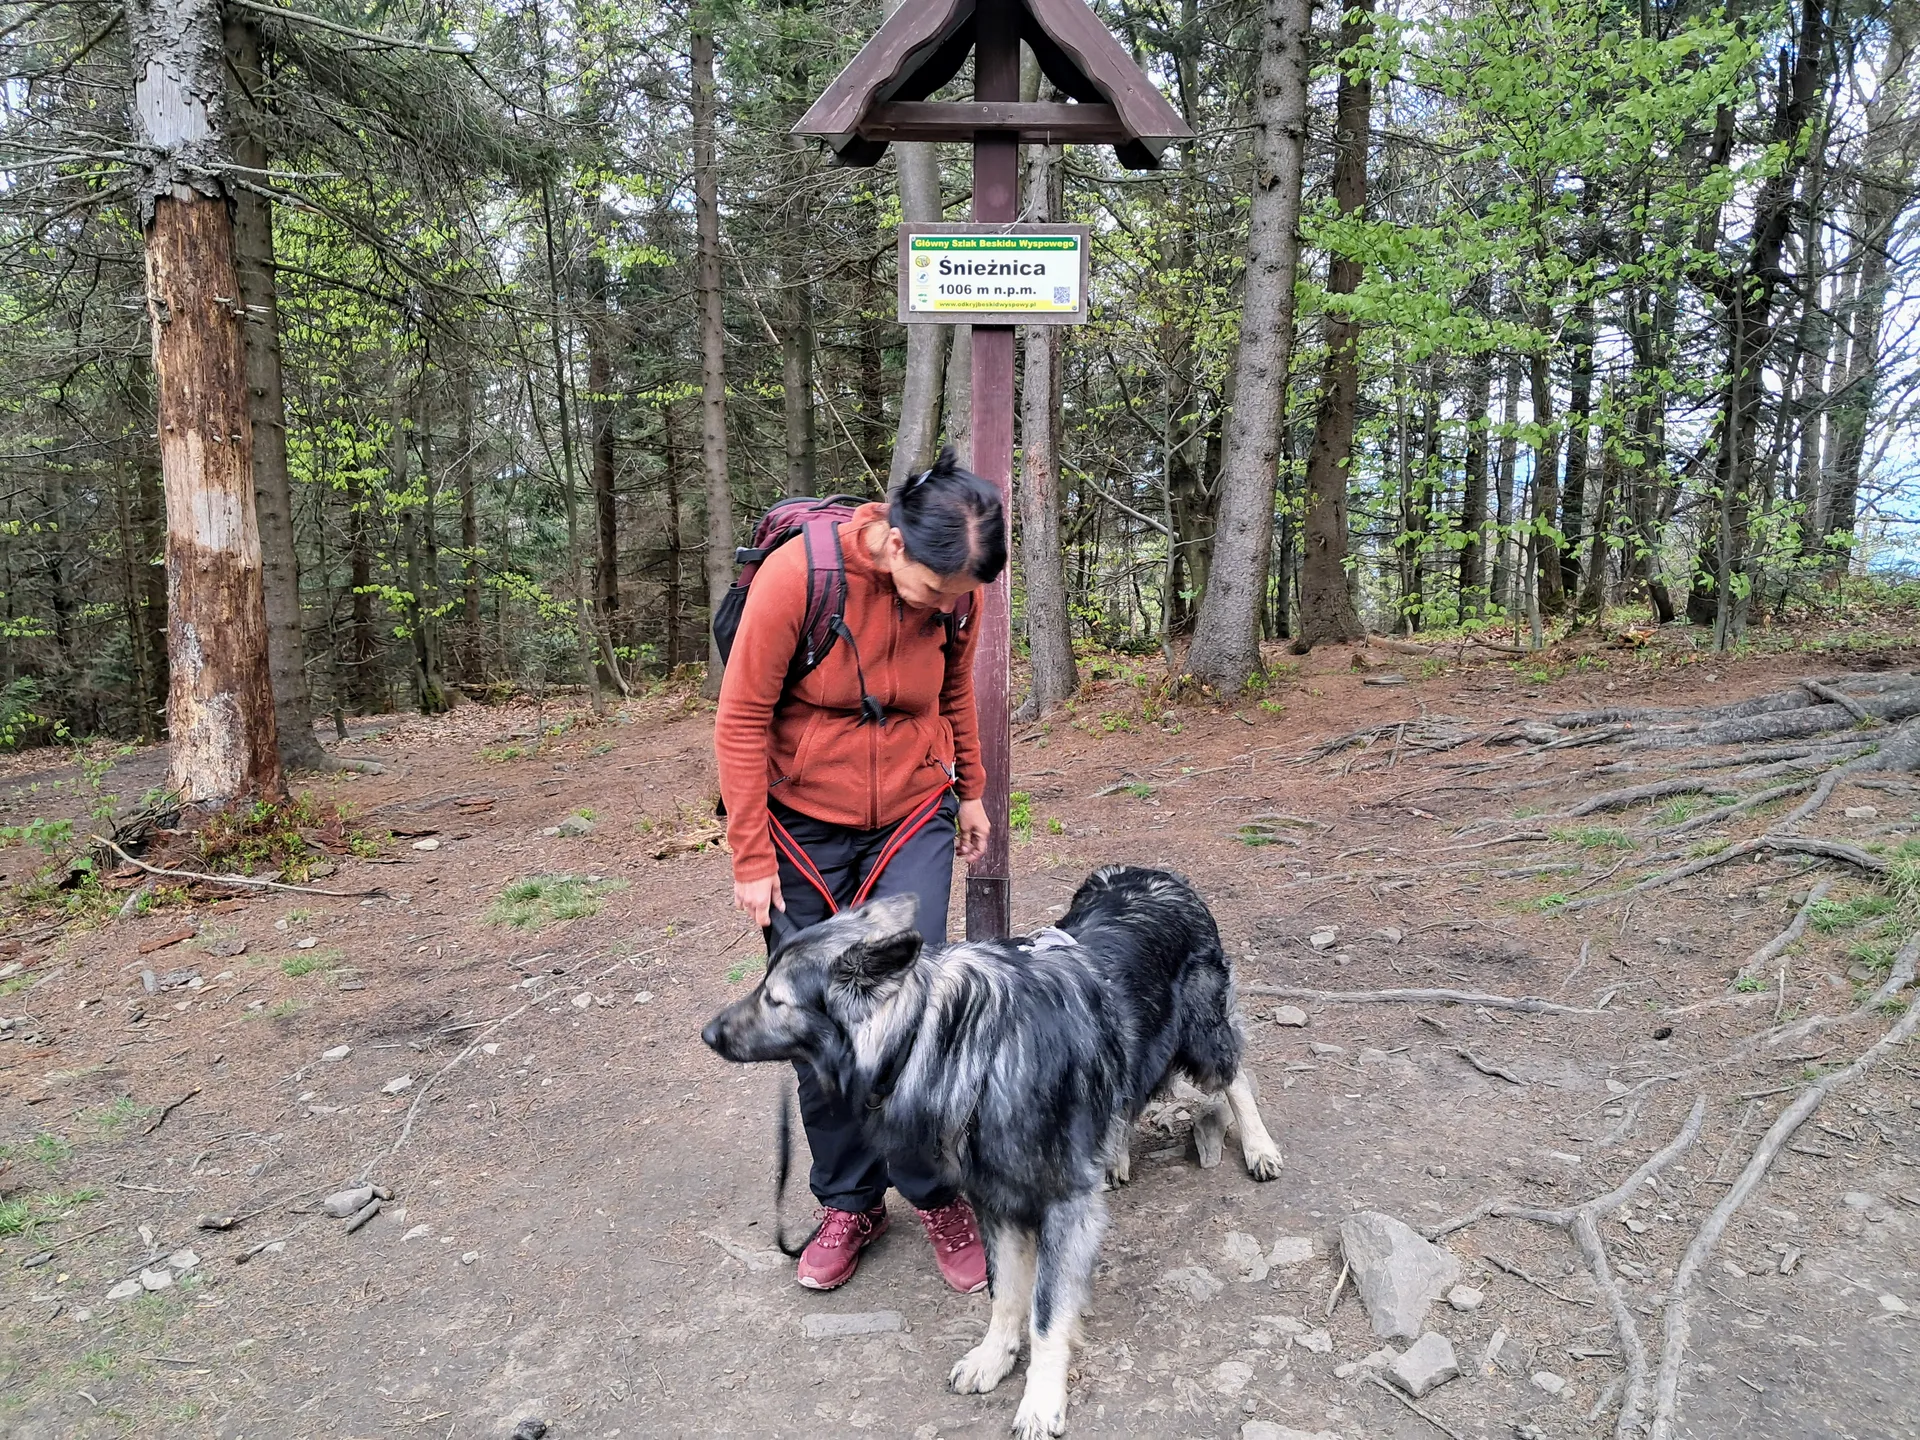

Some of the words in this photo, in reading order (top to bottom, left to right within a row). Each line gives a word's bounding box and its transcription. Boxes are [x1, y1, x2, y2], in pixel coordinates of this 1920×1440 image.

[952, 239, 977, 248] Szlak
[979, 239, 1017, 248] Beskidu
[1019, 239, 1075, 250] Wyspowego
[938, 255, 1046, 276] Śnieżnica
[938, 284, 972, 295] 1006
[977, 286, 989, 295] m
[994, 286, 1037, 297] n.p.m.
[939, 301, 1037, 309] www.odkryjbeskidwyspowy.pl
